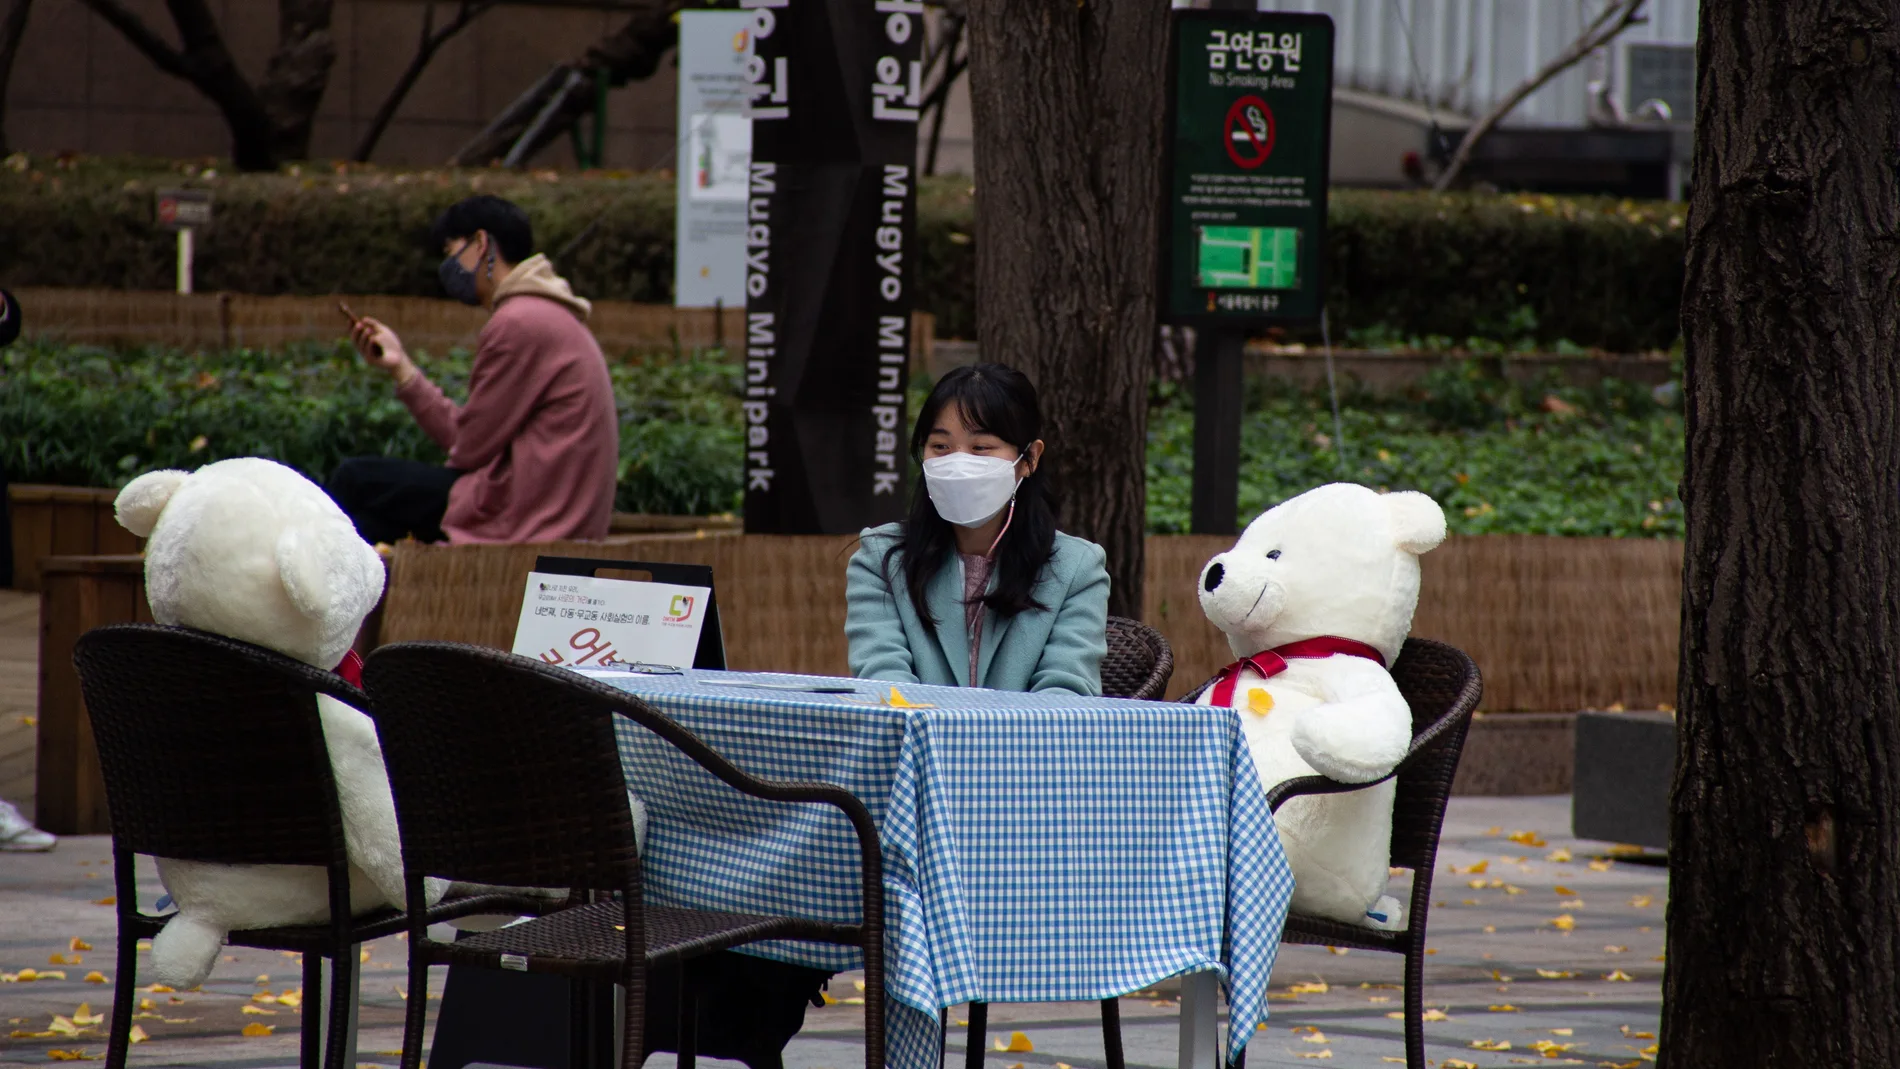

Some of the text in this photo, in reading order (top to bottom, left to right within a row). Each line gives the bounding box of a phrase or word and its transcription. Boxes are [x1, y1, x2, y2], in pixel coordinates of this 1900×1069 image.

[1206, 30, 1302, 72] 금연공원
[1209, 72, 1295, 90] No Smoking Area
[875, 164, 909, 302] Mugyo
[742, 162, 776, 493] Mugyo Minipark
[600, 611, 634, 624] 사회실험의
